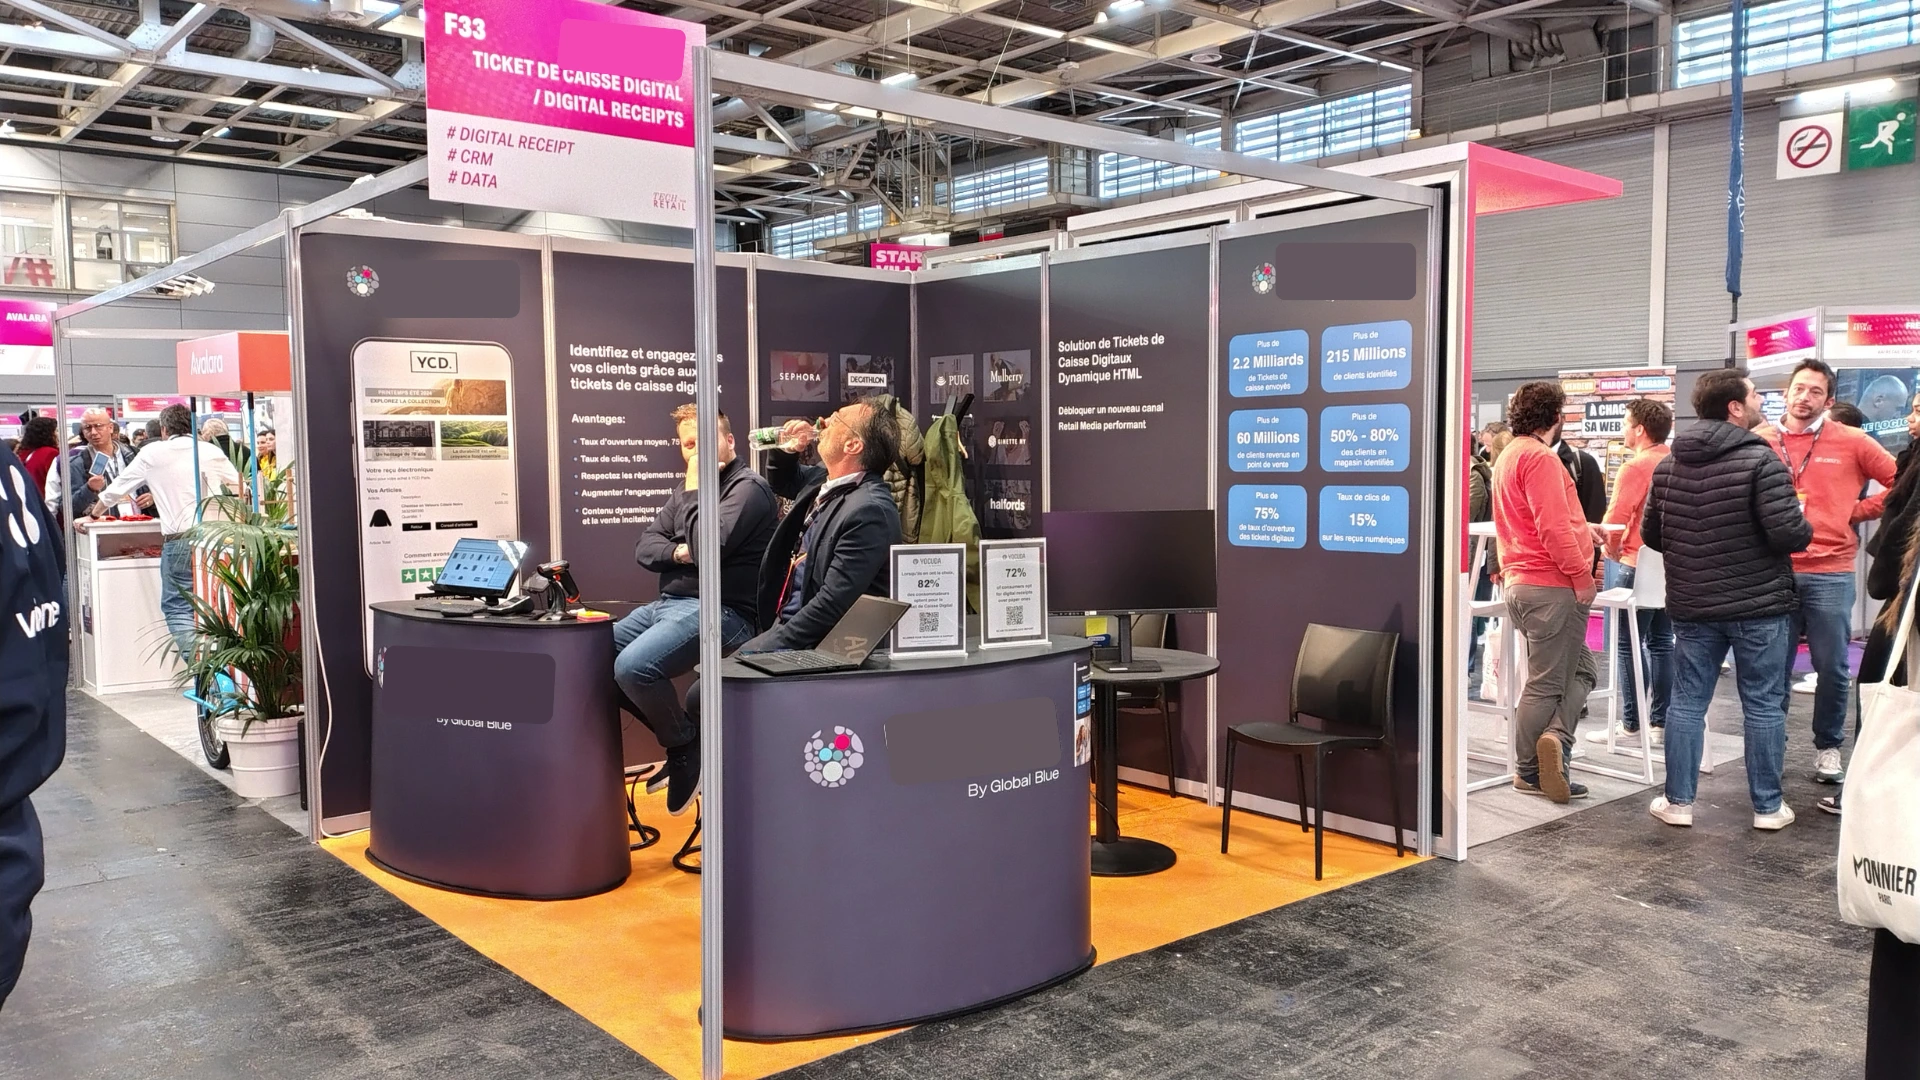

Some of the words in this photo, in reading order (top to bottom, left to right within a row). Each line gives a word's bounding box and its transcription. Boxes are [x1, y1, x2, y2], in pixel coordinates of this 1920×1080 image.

[444, 12, 486, 40] F33
[473, 50, 534, 76] TICKET
[538, 61, 560, 81] DE
[563, 70, 620, 91] CAISSE
[624, 76, 683, 101] DIGITAL
[544, 90, 608, 116] DIGITAL
[611, 101, 684, 128] RECEIPTS
[447, 126, 456, 139] #
[459, 127, 514, 148] DIGITAL
[518, 135, 575, 155] RECEIPT
[448, 148, 457, 161] #
[461, 149, 493, 166] CRM
[448, 170, 457, 184] #
[461, 171, 498, 189] DATA
[654, 200, 686, 210] RETAIL
[6, 313, 47, 322] AVALARA
[1353, 332, 1368, 340] Plus
[1370, 331, 1378, 339] de
[1058, 340, 1096, 352] Solution
[1099, 338, 1110, 348] de
[1113, 335, 1148, 347] Tickets
[1151, 333, 1164, 344] de
[1257, 340, 1270, 348] Plus
[570, 344, 628, 359] Identifiez
[632, 348, 644, 359] et
[647, 350, 696, 363] engagez
[1327, 350, 1350, 363] 215
[1353, 346, 1407, 361] Millions
[190, 350, 224, 375] Avalara
[417, 356, 452, 369] YCD.
[1058, 356, 1090, 368] Caisse
[1092, 353, 1132, 367] Digitaux
[1233, 357, 1250, 370] 2.2
[1253, 353, 1304, 368] Milliards
[570, 363, 592, 373] vos
[596, 363, 637, 375] clients
[640, 365, 675, 377] grâce
[678, 368, 698, 377] aux
[1344, 372, 1365, 380] clients
[1367, 370, 1397, 378] identifiés
[780, 372, 821, 382] SEPHORA
[850, 375, 885, 384] DECATHLON
[949, 374, 970, 385] PUIG
[990, 370, 1023, 383] Mulberry
[1058, 371, 1110, 385] Dynamique
[1113, 368, 1142, 380] HTML
[1258, 373, 1278, 381] Tickets
[571, 378, 613, 390] tickets
[616, 379, 632, 391] de
[635, 381, 673, 392] caisse
[1265, 383, 1291, 392] envoyés
[1601, 381, 1629, 389] MARQUE
[1059, 406, 1095, 416] Débloquer
[1108, 405, 1140, 413] nouveau
[1142, 402, 1164, 412] canal
[1590, 403, 1597, 416] À
[1599, 404, 1626, 415] CHAC
[572, 414, 625, 425] Avantages:
[1368, 412, 1377, 420] de
[1059, 422, 1078, 430] Retail
[1080, 421, 1101, 430] Media
[1104, 420, 1146, 431] performant
[1585, 422, 1597, 432] SA
[1237, 432, 1250, 444] 60
[1254, 431, 1300, 444] Millions
[1330, 429, 1358, 442] 50%
[1370, 428, 1399, 442] 80%
[644, 439, 670, 447] moyen,
[611, 455, 630, 463] clics,
[1334, 459, 1362, 467] magasin
[1364, 458, 1394, 466] identifiés
[581, 472, 620, 480] Respectez
[582, 490, 623, 498] Augmenter
[1364, 493, 1380, 501] clics
[1381, 493, 1390, 501] de
[990, 499, 1025, 511] halfords
[615, 507, 654, 515] dynamique
[1254, 507, 1279, 519] 75%
[1350, 514, 1377, 527] 15%
[1262, 524, 1295, 532] d'ouverture
[1271, 535, 1294, 543] digitaux
[1345, 535, 1364, 543] reçus
[1365, 536, 1405, 545] numériques
[1006, 568, 1026, 577] 72%
[487, 721, 512, 730] Blue
[968, 784, 987, 799] By
[990, 774, 1031, 793] Global
[1035, 769, 1059, 784] Blue
